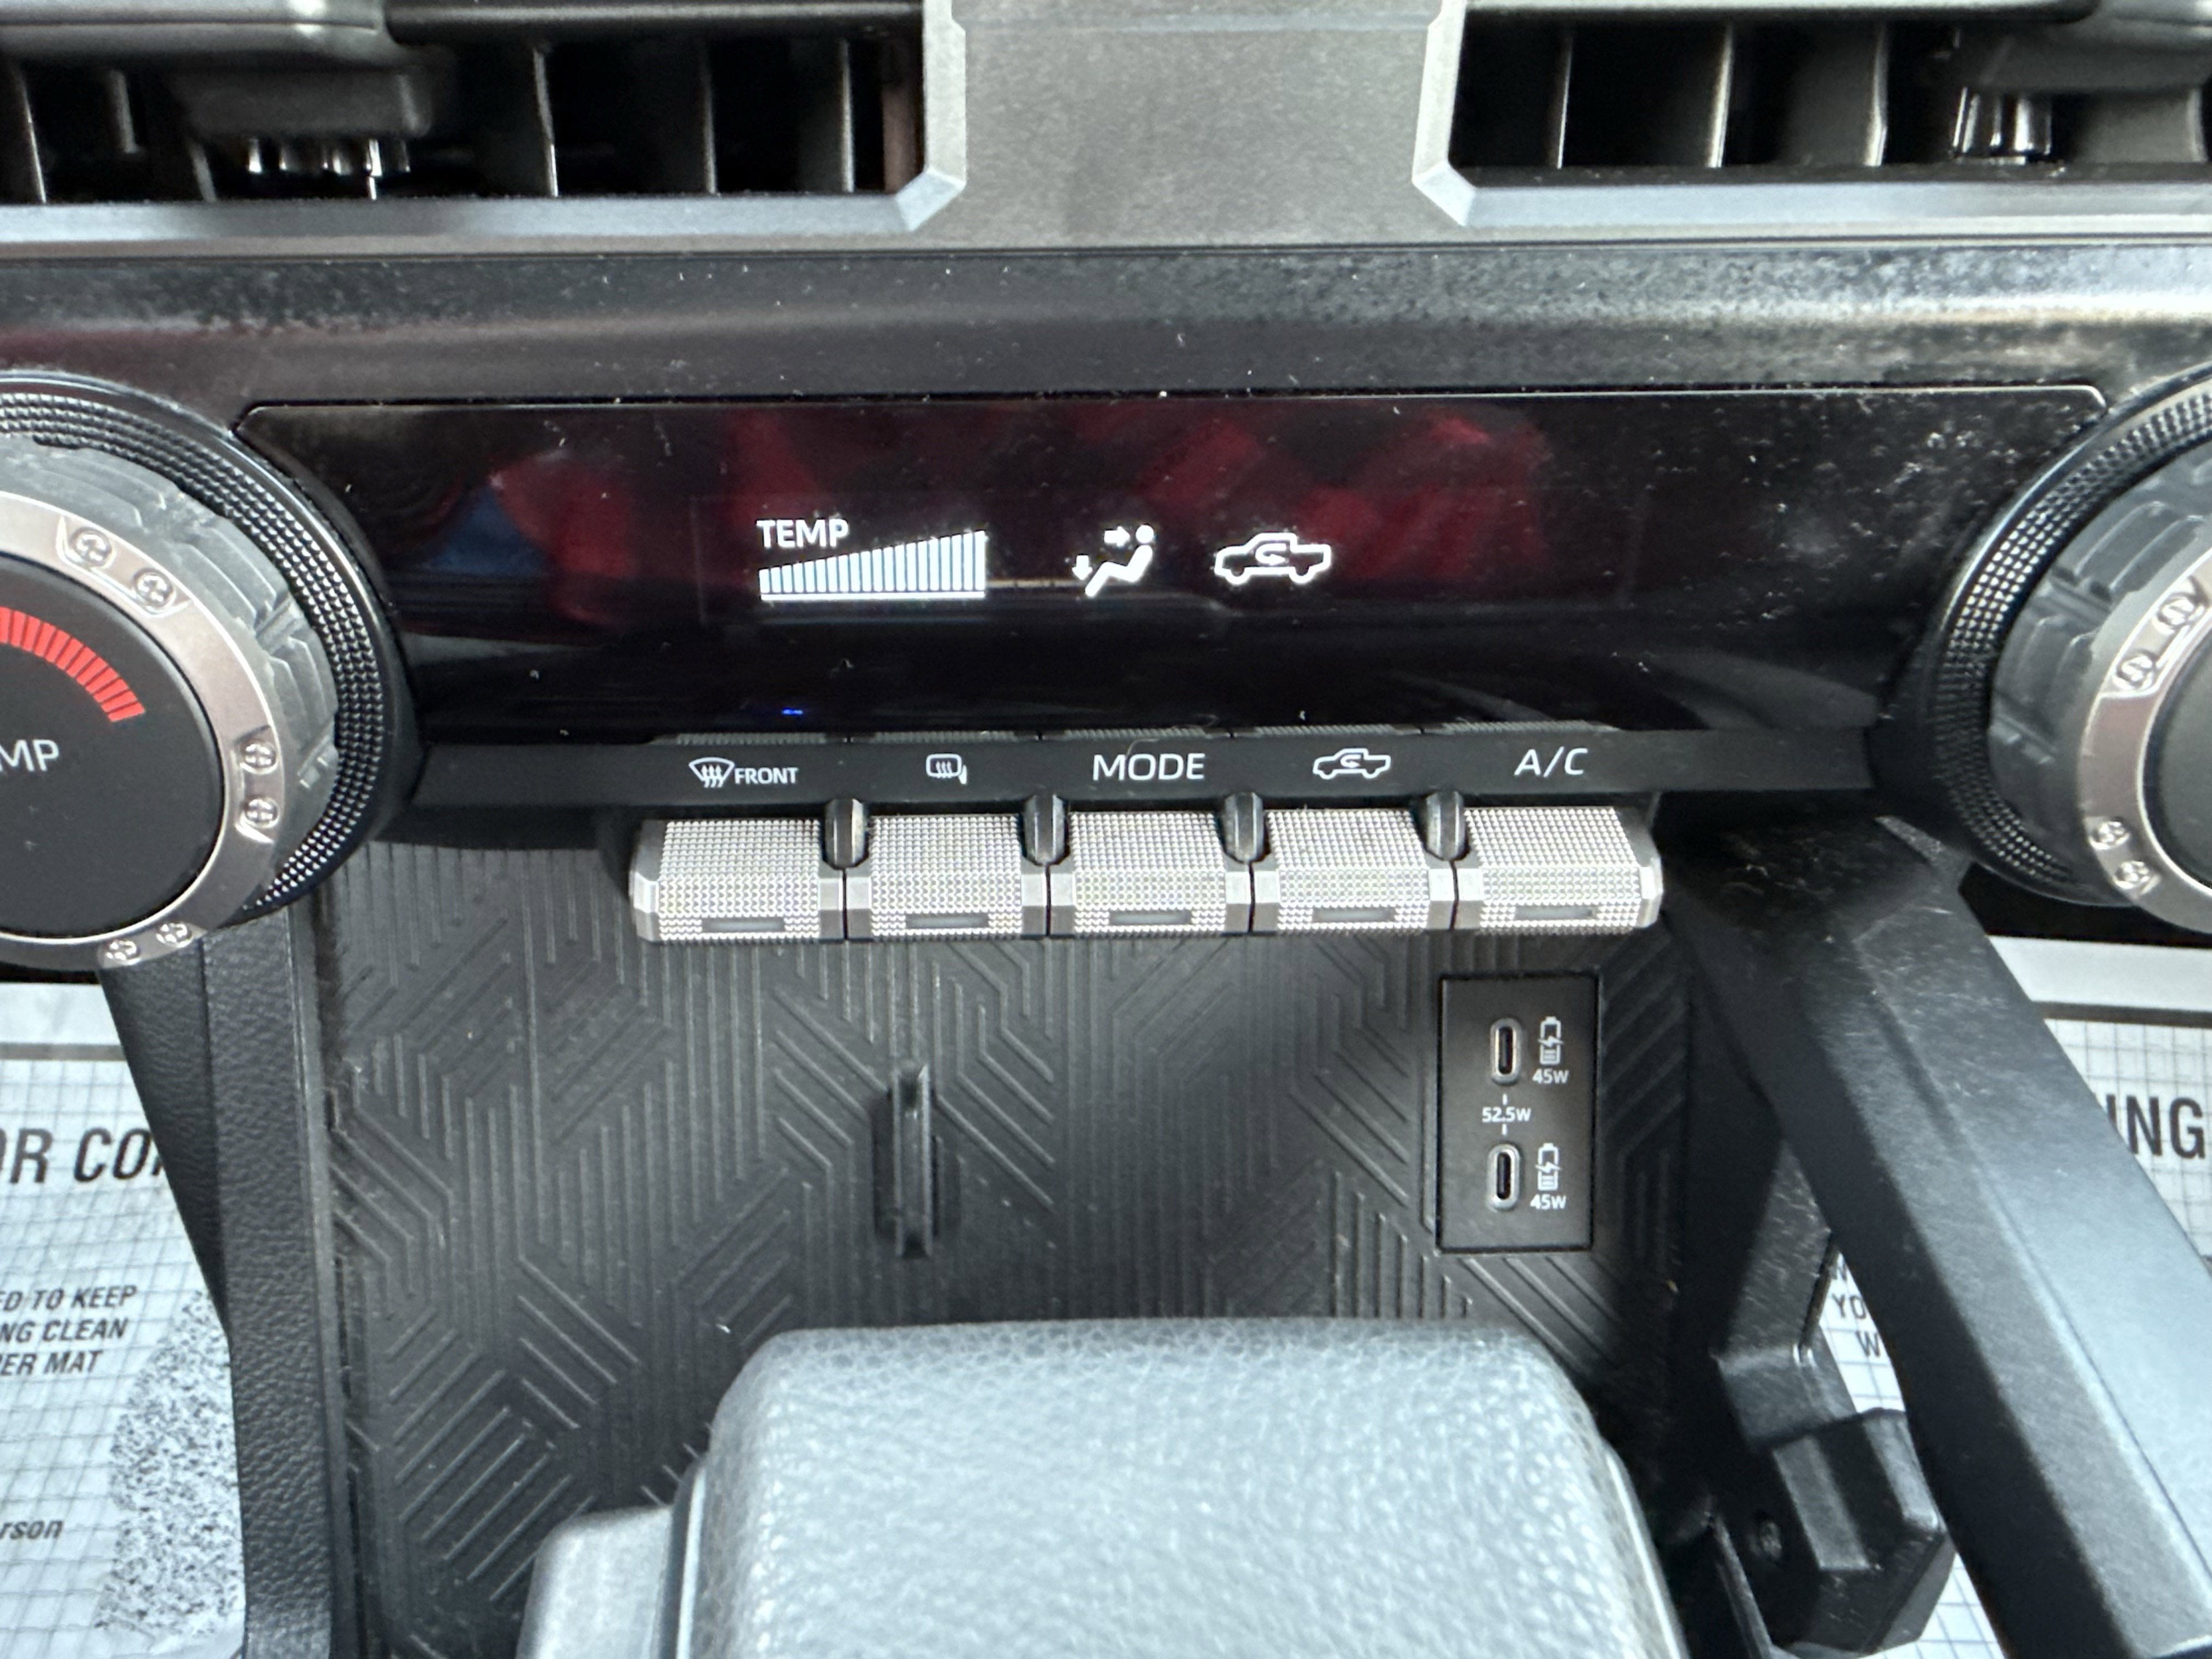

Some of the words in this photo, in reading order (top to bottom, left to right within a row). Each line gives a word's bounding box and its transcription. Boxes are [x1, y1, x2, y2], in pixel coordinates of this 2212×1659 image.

[756, 518, 849, 548] TEMP
[1092, 753, 1206, 781] MODE
[1514, 746, 1588, 777] A/C
[735, 767, 799, 784] FRONT
[1532, 1068, 1570, 1084] 45W
[1482, 1106, 1532, 1123] 52.5W
[0, 1127, 53, 1183] R
[1530, 1194, 1566, 1210] 45W
[32, 1288, 64, 1311] TO
[71, 1284, 137, 1308] KEEP
[43, 1318, 128, 1342] CLEAN
[0, 1353, 37, 1376] ER
[43, 1350, 103, 1374] MAT
